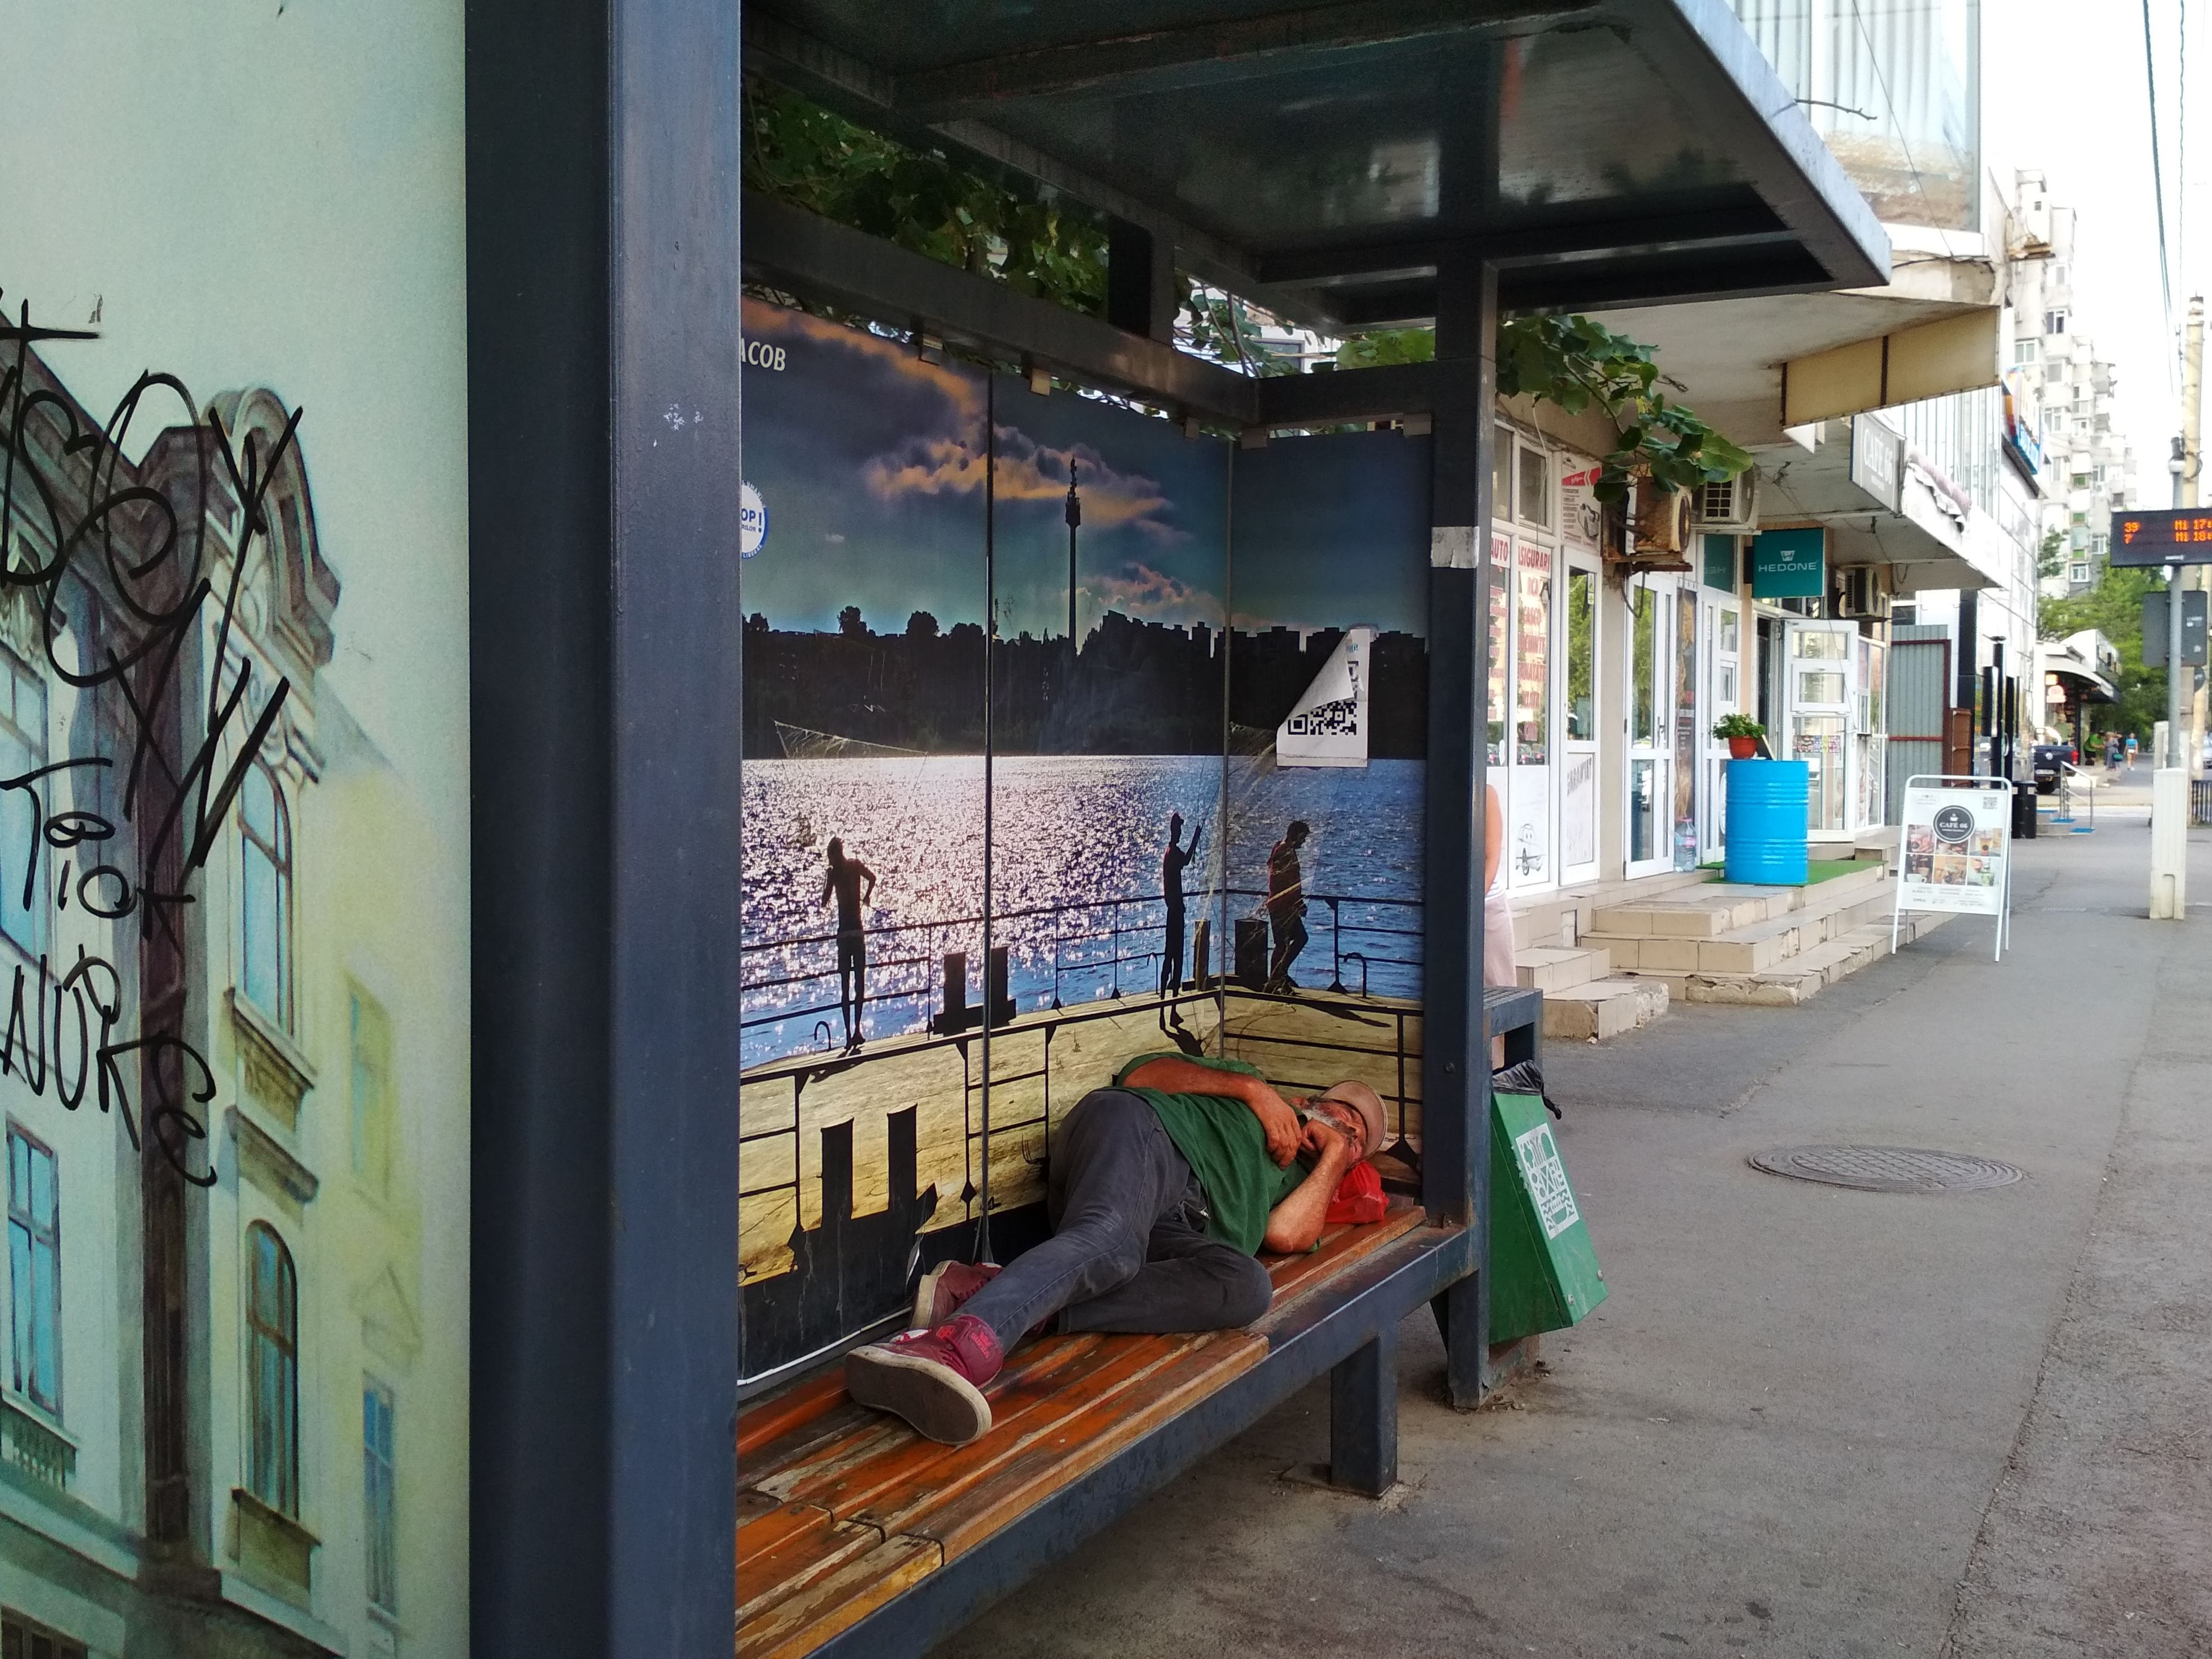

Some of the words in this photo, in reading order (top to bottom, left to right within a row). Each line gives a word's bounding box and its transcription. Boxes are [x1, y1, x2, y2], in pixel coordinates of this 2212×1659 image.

[2124, 522, 2140, 533] 39
[2124, 534, 2133, 544] 7
[1491, 537, 1509, 562] AUTO
[1758, 562, 1817, 572] HEDONE
